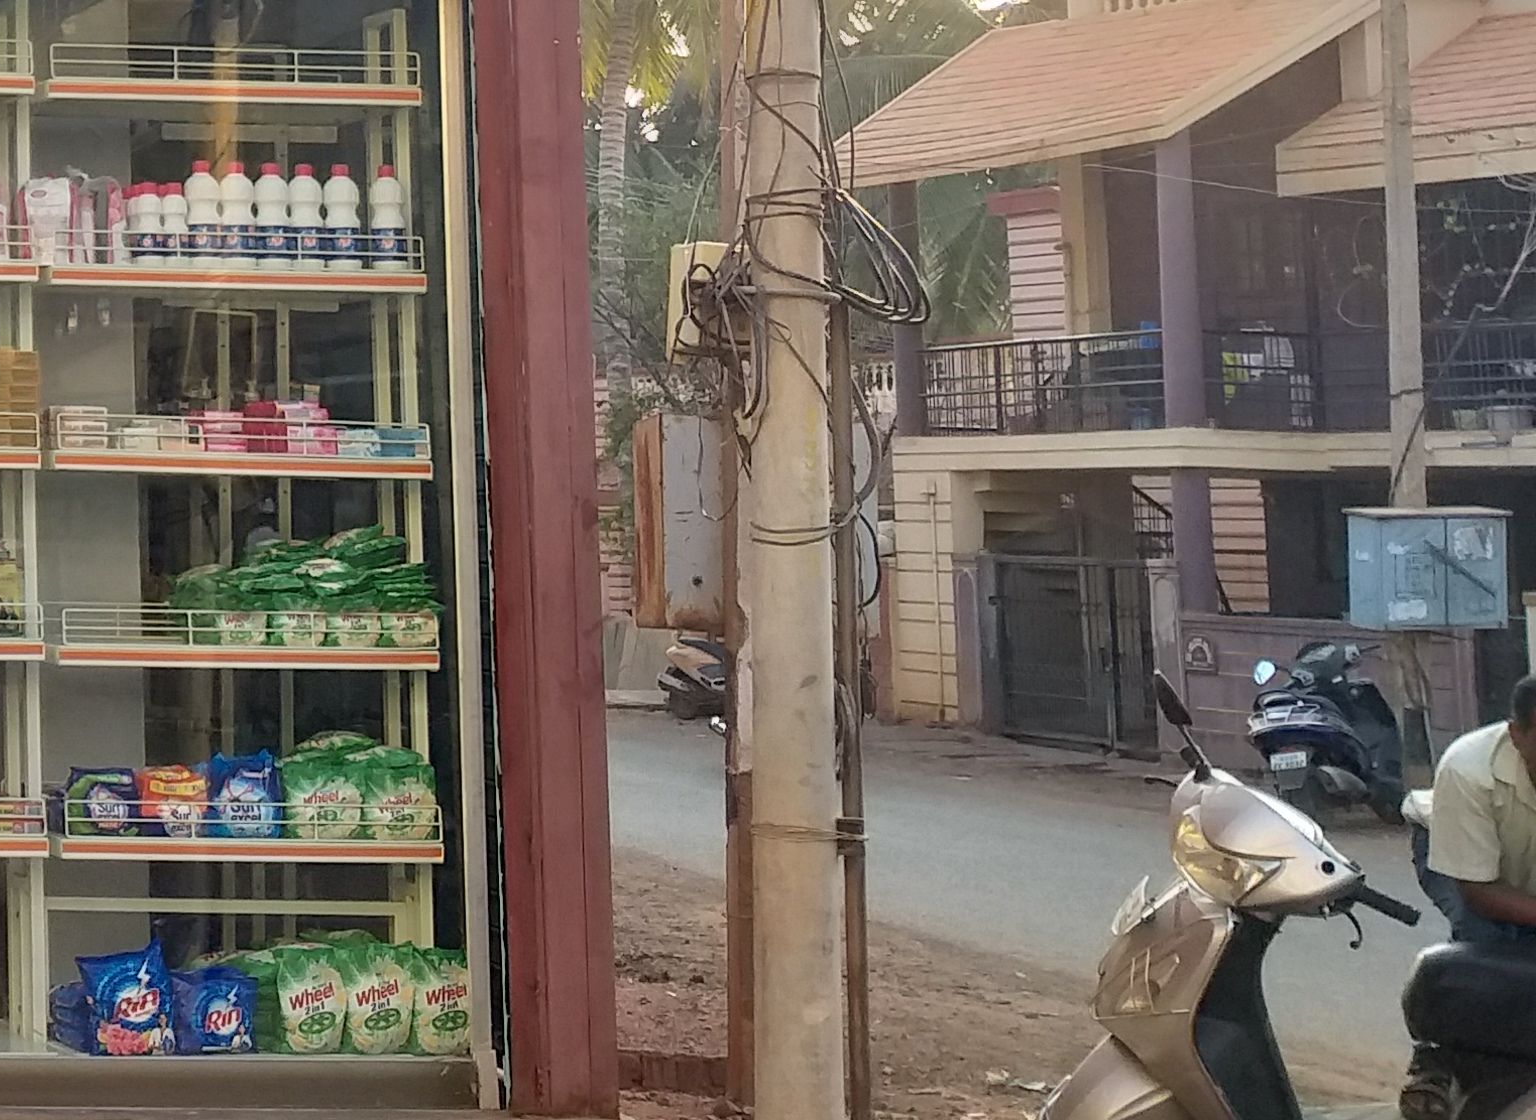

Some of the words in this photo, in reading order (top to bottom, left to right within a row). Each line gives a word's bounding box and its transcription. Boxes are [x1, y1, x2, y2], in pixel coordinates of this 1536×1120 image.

[289, 982, 335, 1011] Wheel
[356, 979, 400, 1007] Wheel
[425, 983, 468, 1007] Wheel
[205, 1007, 242, 1033] Rin
